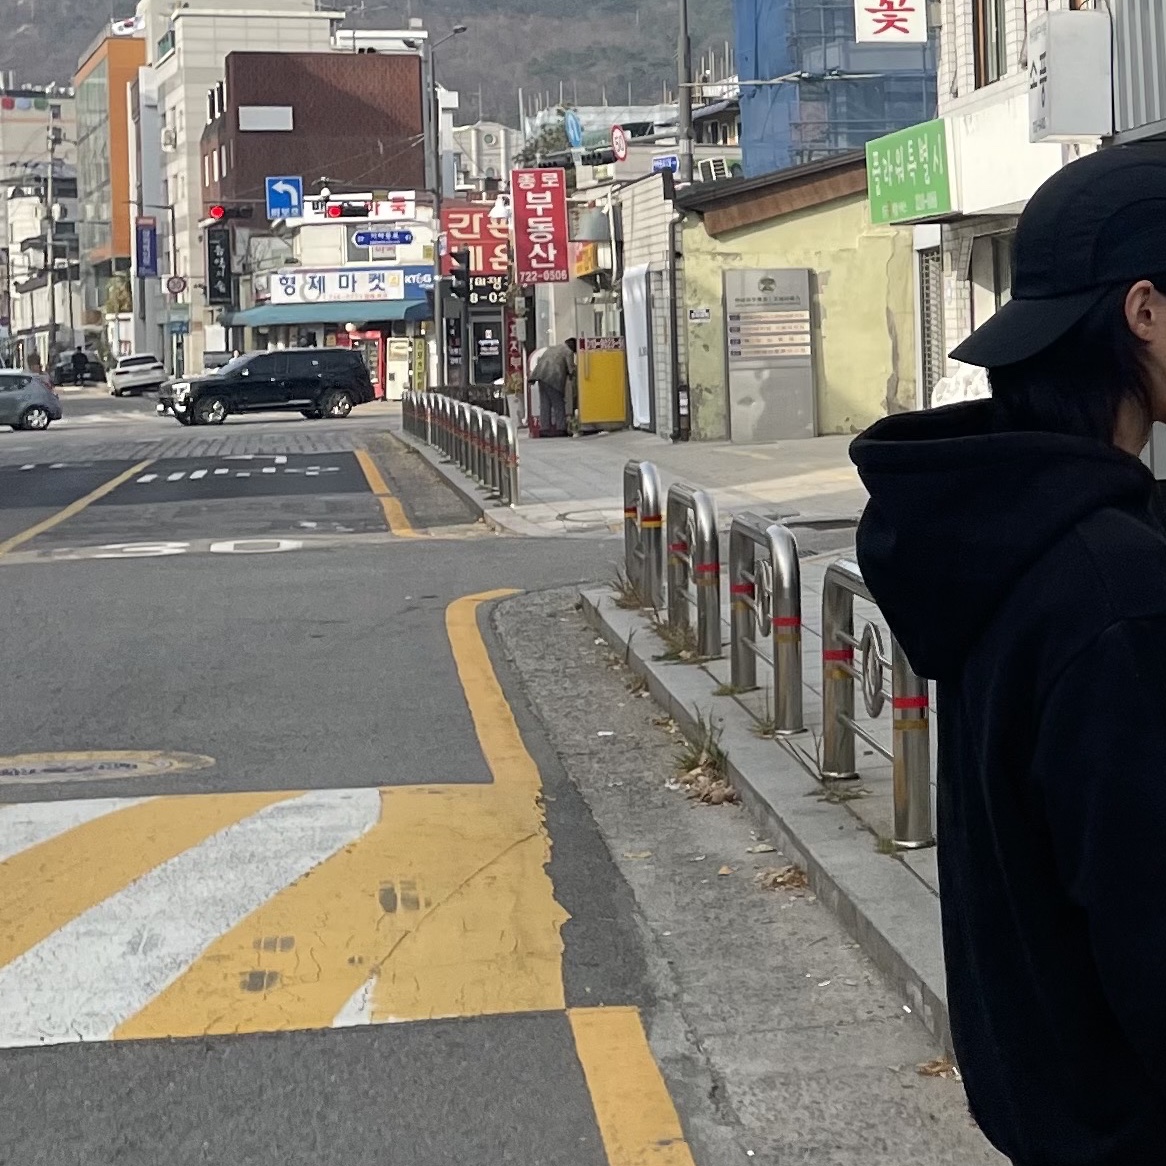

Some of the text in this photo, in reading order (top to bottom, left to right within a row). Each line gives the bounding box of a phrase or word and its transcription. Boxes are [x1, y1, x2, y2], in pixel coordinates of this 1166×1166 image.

[1029, 51, 1048, 108] 소풍
[518, 172, 560, 190] 종로
[872, 133, 944, 197] 플라워특별시
[525, 190, 557, 269] 부동산
[279, 272, 386, 296] 형제마켓
